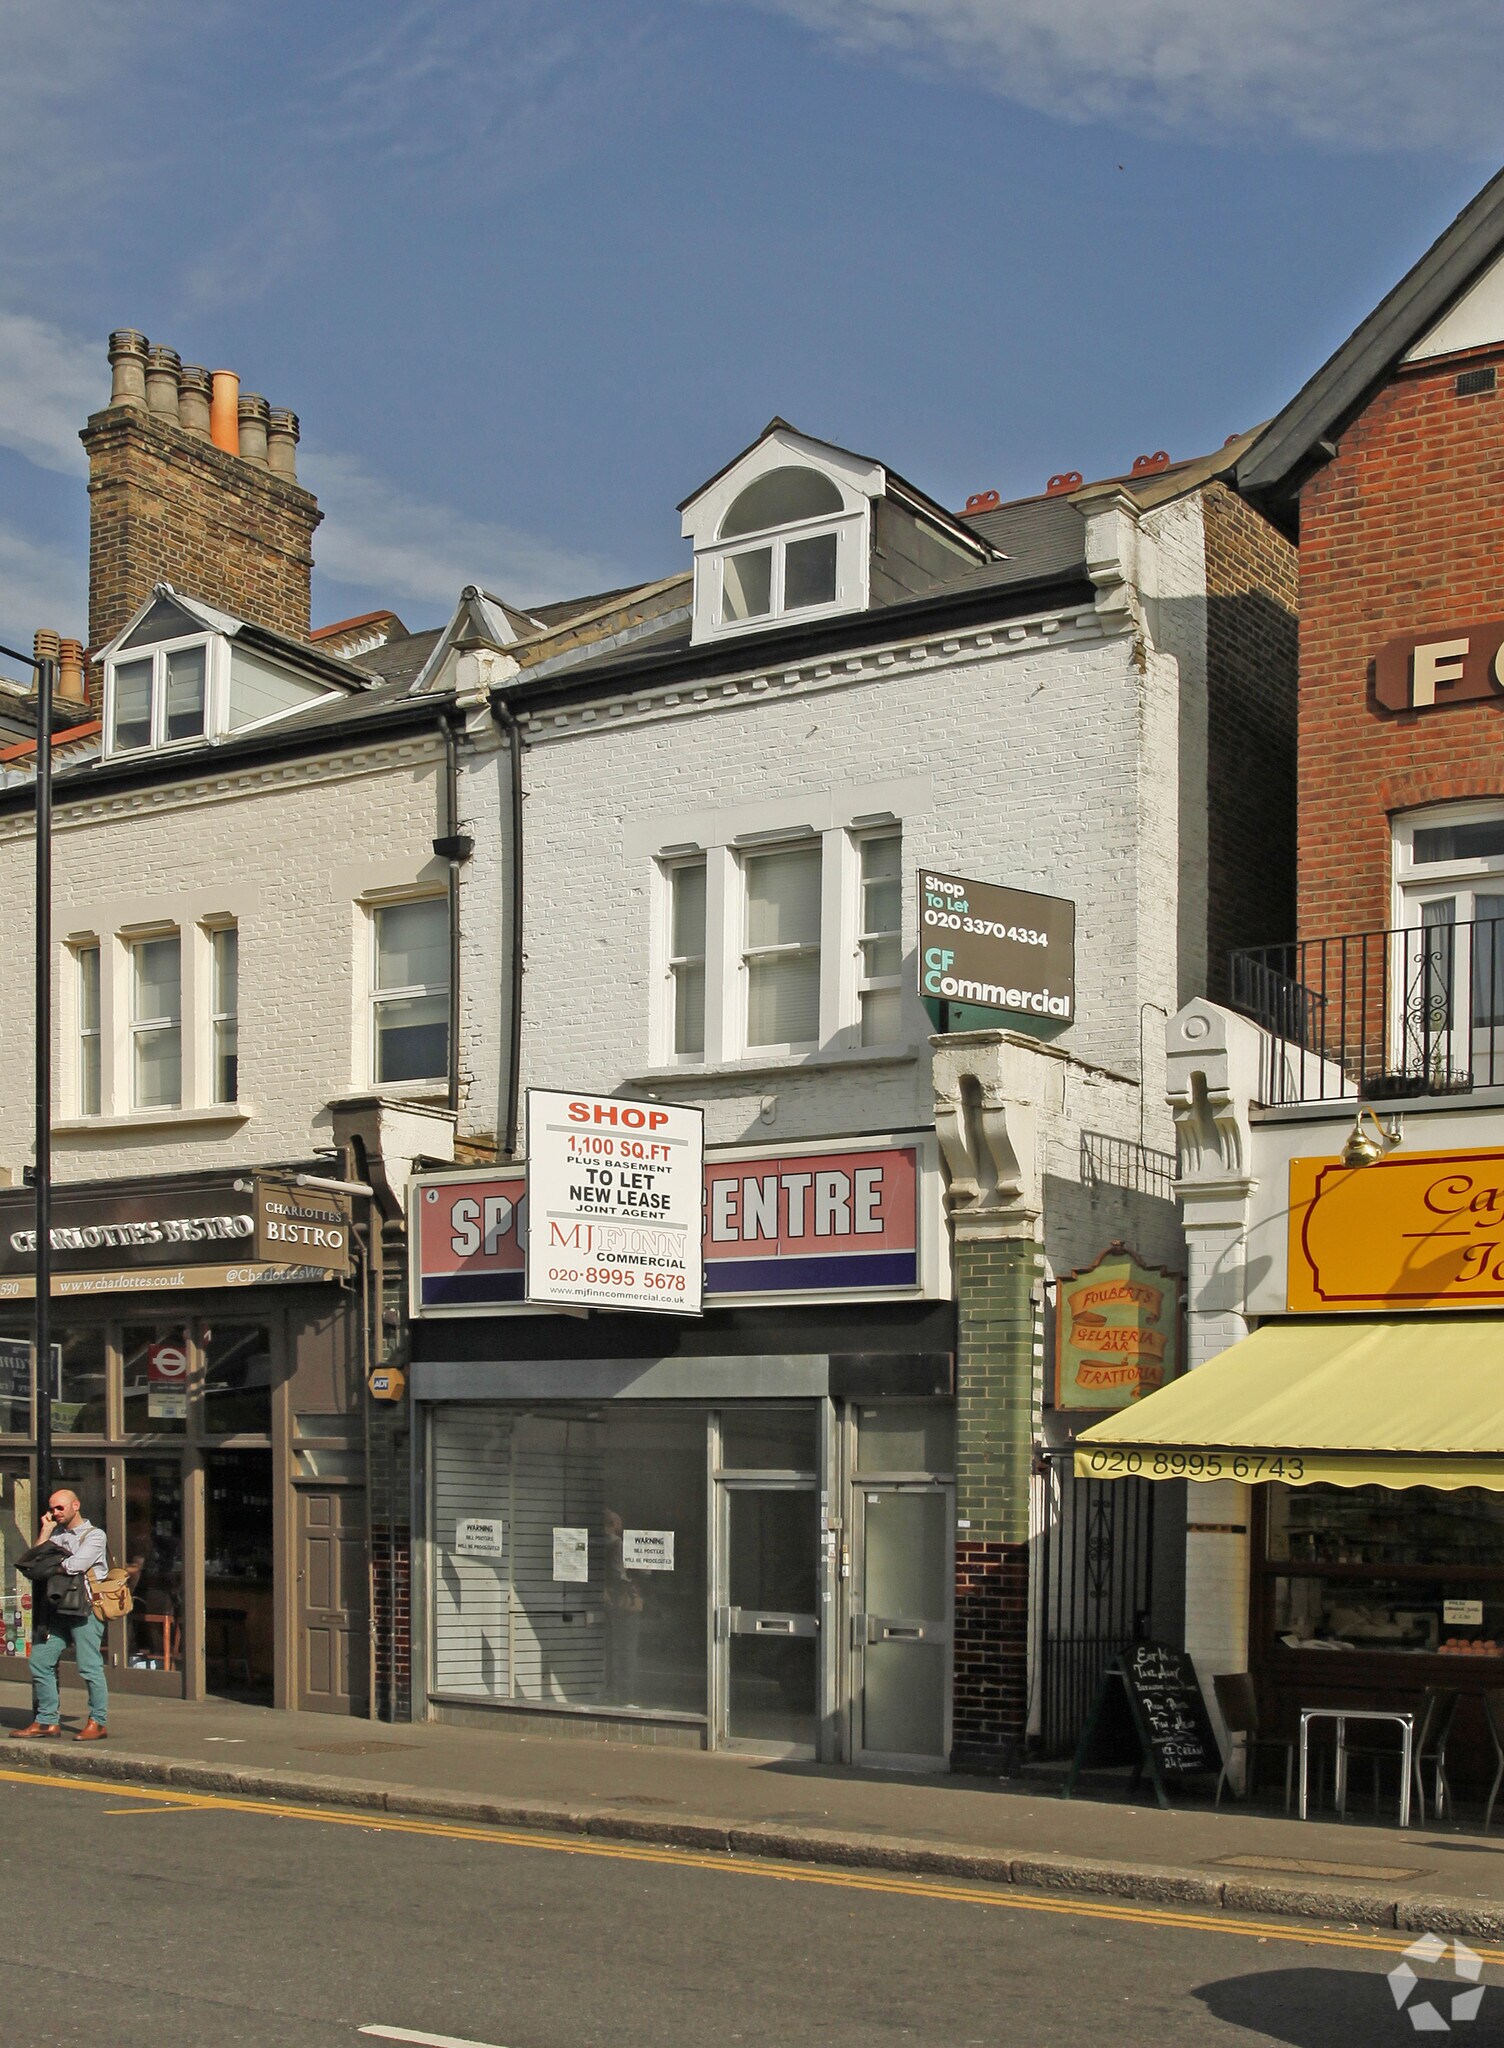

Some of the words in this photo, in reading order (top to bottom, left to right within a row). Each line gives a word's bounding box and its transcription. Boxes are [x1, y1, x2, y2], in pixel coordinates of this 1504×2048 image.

[1412, 637, 1504, 708] F
[925, 876, 965, 898] Shop
[925, 893, 944, 909] To
[947, 897, 969, 914] Let
[924, 910, 961, 930] 020
[963, 917, 1006, 938] 3370
[1007, 927, 1048, 947] 4334
[925, 948, 955, 972] CF
[925, 970, 1070, 1017] Commercial
[567, 1102, 669, 1130] SHOP
[567, 1135, 614, 1157] 1,100
[620, 1140, 671, 1162] SQ.FT
[567, 1156, 600, 1167] PLUS
[605, 1159, 673, 1174] BASEMENT
[586, 1168, 613, 1186] TO
[620, 1172, 655, 1190] LET
[428, 1191, 436, 1201] 4
[569, 1185, 611, 1204] NEW
[617, 1190, 671, 1210] LEASE
[703, 1167, 884, 1243] ENTRE
[575, 1204, 618, 1215] JOINT
[622, 1209, 666, 1220] AGENT
[162, 1214, 254, 1243] BISTRO
[267, 1221, 343, 1249] BISTRO
[596, 1252, 687, 1269] COMMERCIAL
[60, 1272, 185, 1292] www.charlottes.co.uk
[643, 1272, 686, 1291] 5678
[549, 1287, 685, 1304] www.mjfinncommercial.co.uk
[1077, 1330, 1154, 1345] GELATERIA
[1100, 1341, 1129, 1351] BAR
[374, 1379, 389, 1388] ADT
[1083, 1368, 1158, 1384] TRATTORIA
[1090, 1450, 1143, 1473] 020
[1153, 1453, 1223, 1476] 8995
[1232, 1455, 1304, 1480] 6743
[466, 1524, 493, 1533] WARNING
[634, 1537, 664, 1545] WARNING
